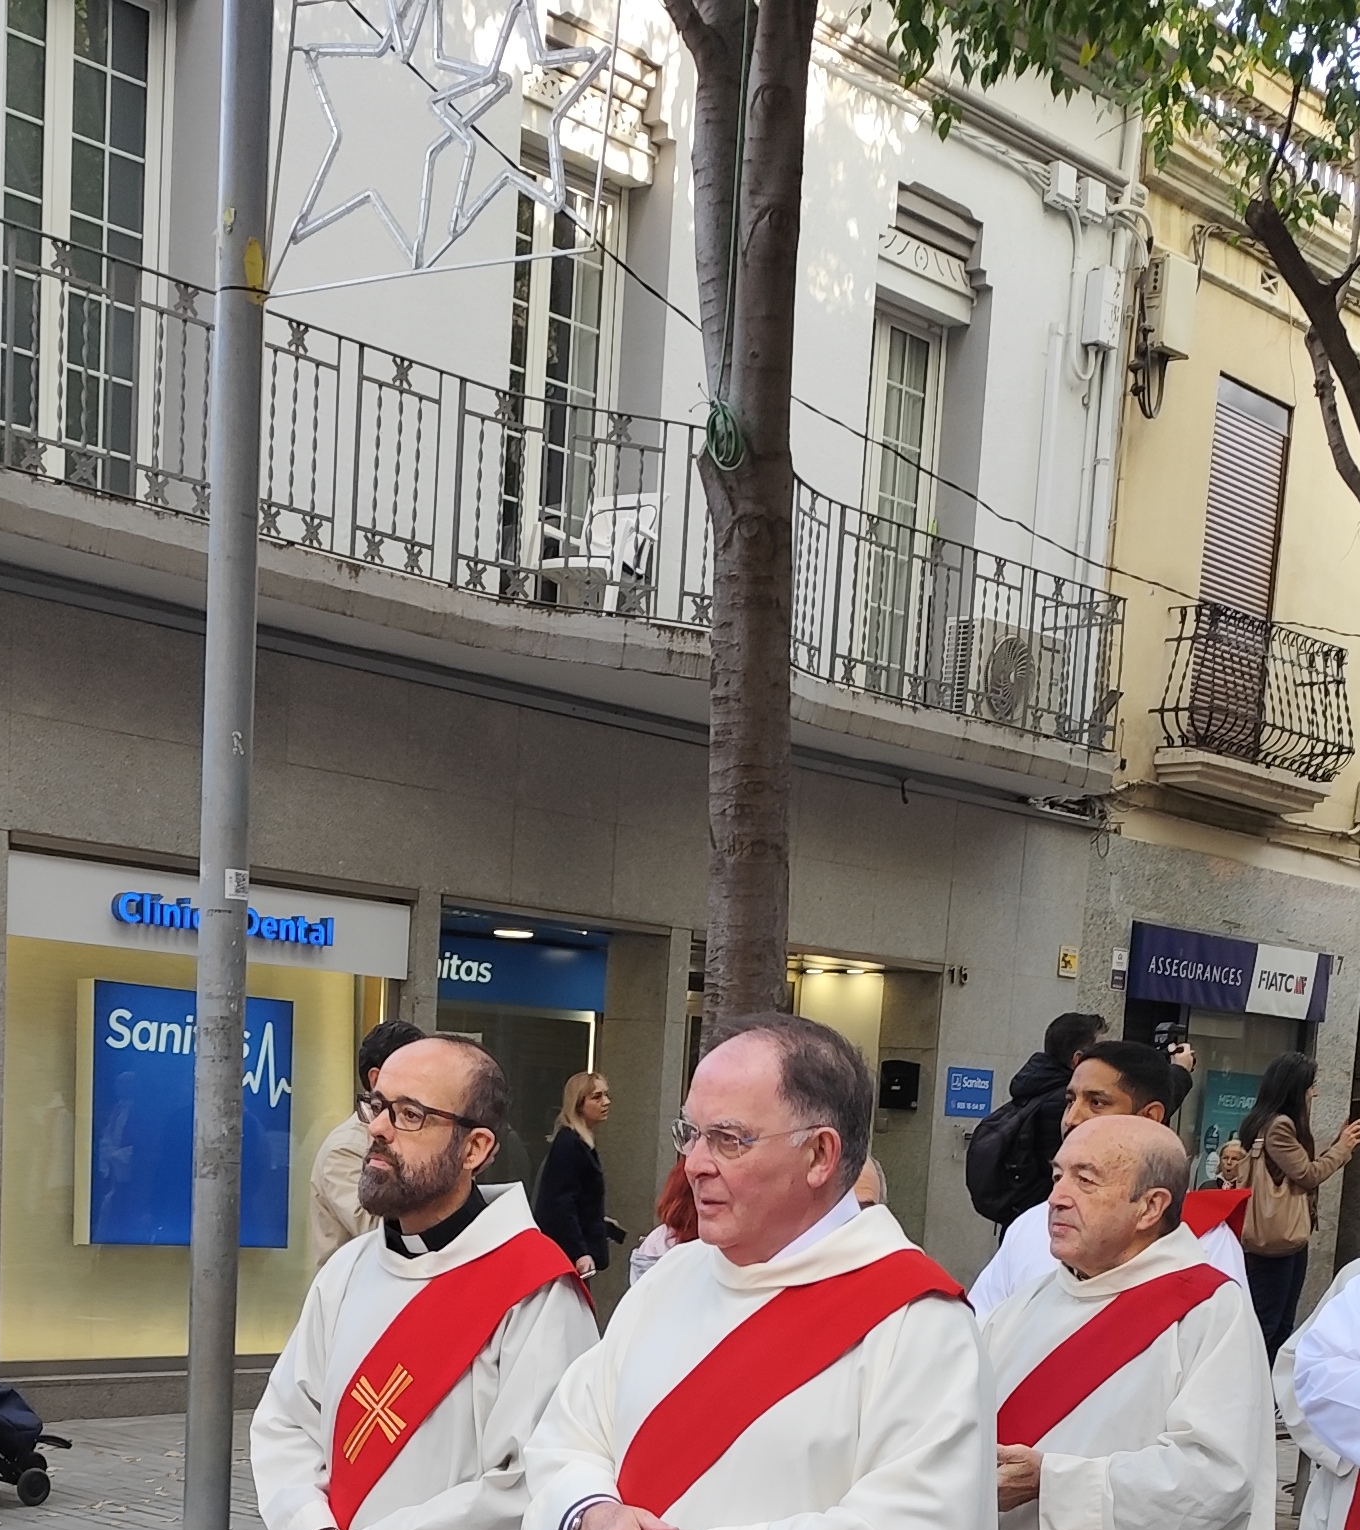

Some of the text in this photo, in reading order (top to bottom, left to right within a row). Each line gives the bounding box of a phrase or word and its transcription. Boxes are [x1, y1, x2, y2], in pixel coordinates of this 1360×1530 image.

[247, 907, 334, 946] Dental
[437, 951, 493, 983] itas
[948, 965, 968, 987] 15
[1148, 955, 1243, 987] ASSEGURANCES
[1257, 969, 1295, 994] FIATC
[962, 1076, 990, 1089] Sanitas
